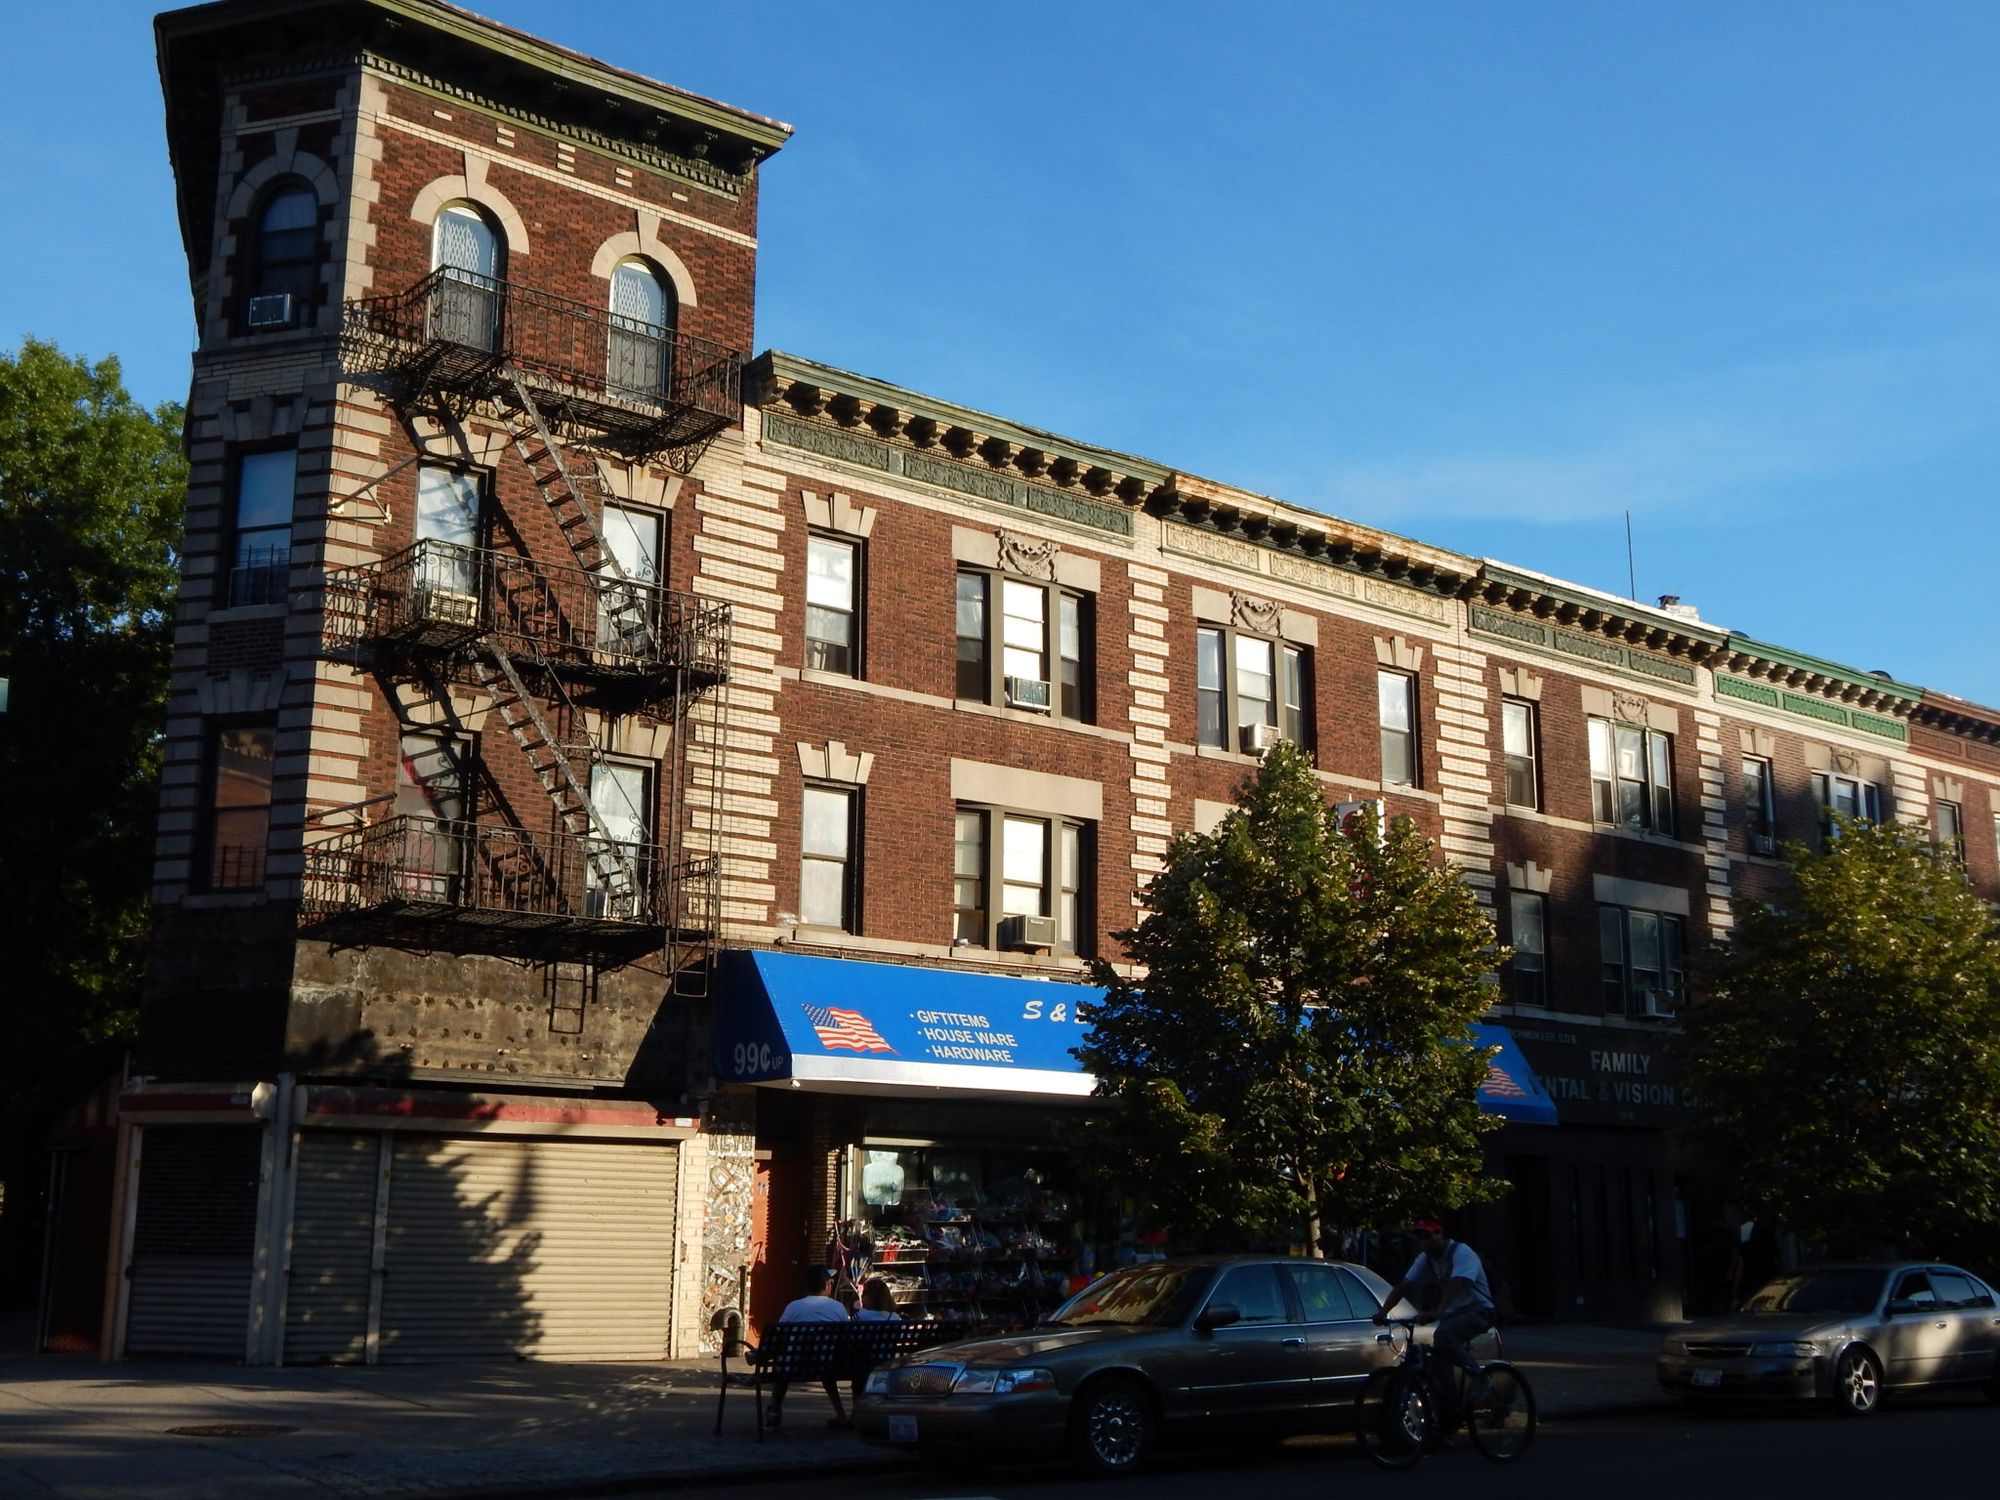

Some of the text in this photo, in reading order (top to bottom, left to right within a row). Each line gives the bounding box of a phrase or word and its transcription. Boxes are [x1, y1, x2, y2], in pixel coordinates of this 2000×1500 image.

[917, 1010, 989, 1028] GIFTITEMS
[1022, 1000, 1044, 1020] S
[1049, 1002, 1067, 1023] &
[924, 1027, 1018, 1047] HOUSE WARE
[771, 1055, 784, 1070] UP
[931, 1045, 1014, 1063] HARDWARE
[1590, 1050, 1650, 1075] FAMILY
[1597, 1081, 1609, 1101] &
[1612, 1081, 1675, 1106] VISION
